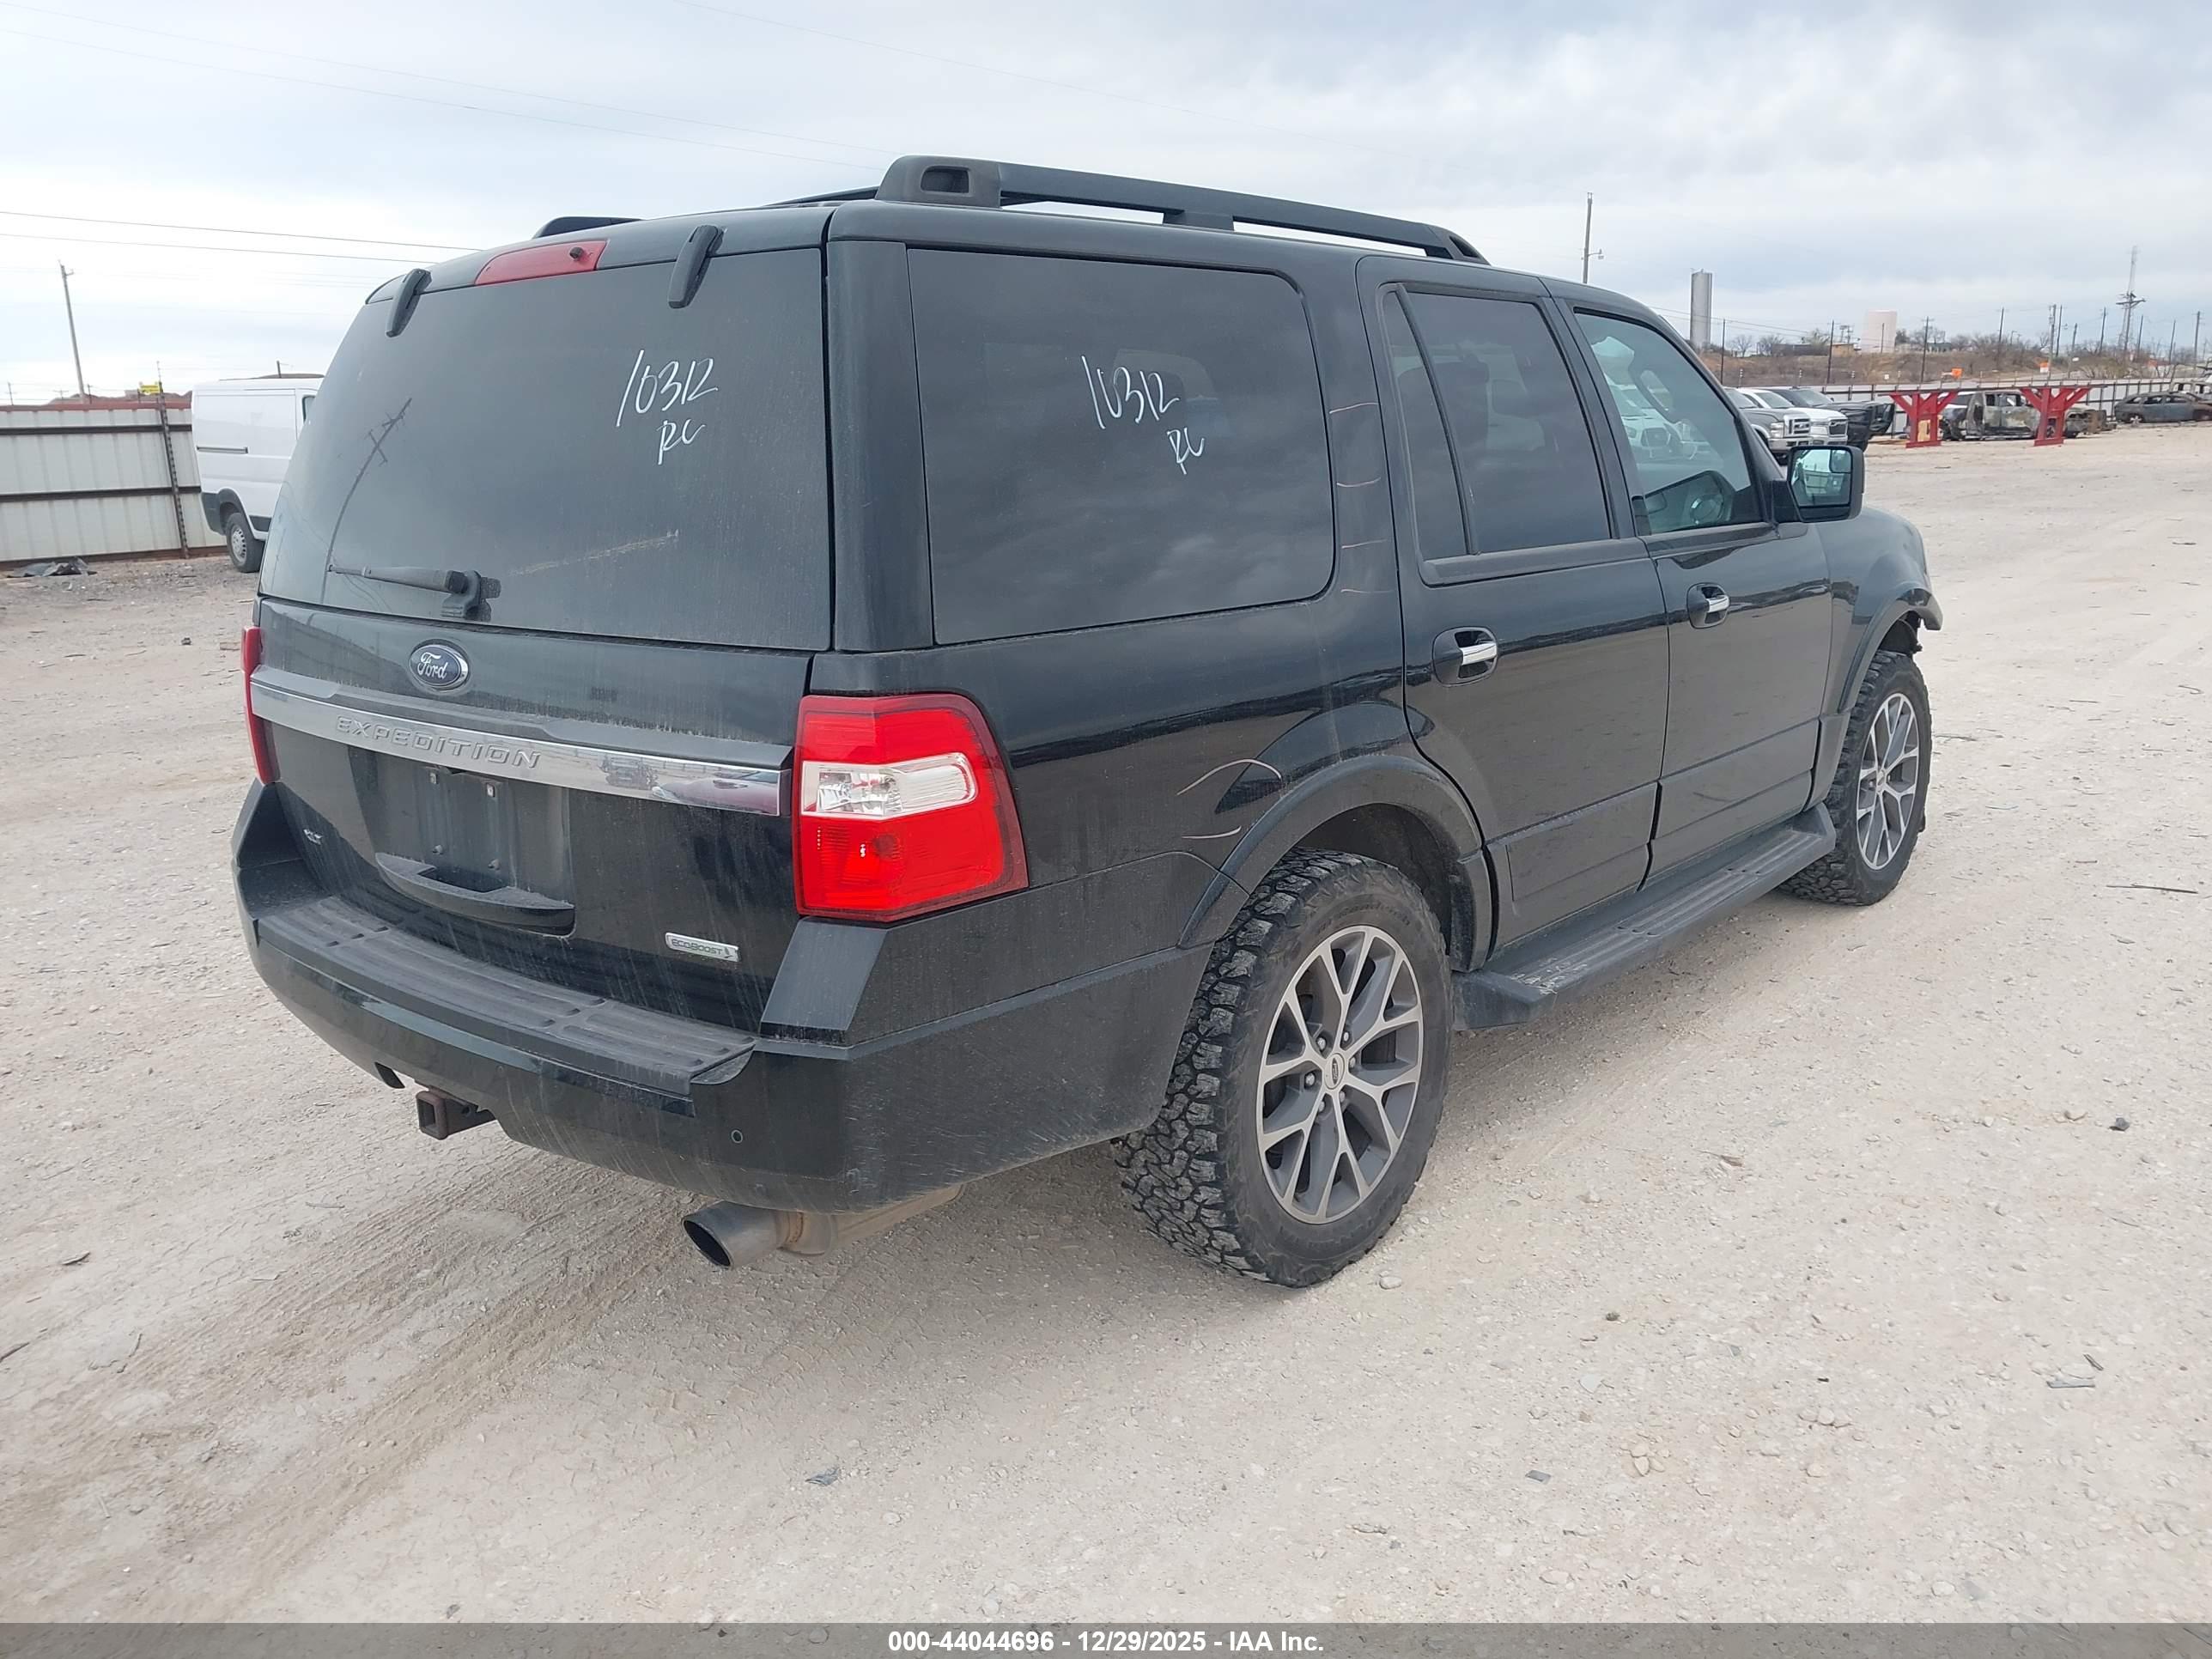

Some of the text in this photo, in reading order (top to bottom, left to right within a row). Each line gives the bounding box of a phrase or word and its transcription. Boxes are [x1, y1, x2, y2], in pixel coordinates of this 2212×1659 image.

[616, 349, 719, 428] 10312
[416, 651, 449, 680] Ford
[337, 714, 541, 769] EXPEDITION
